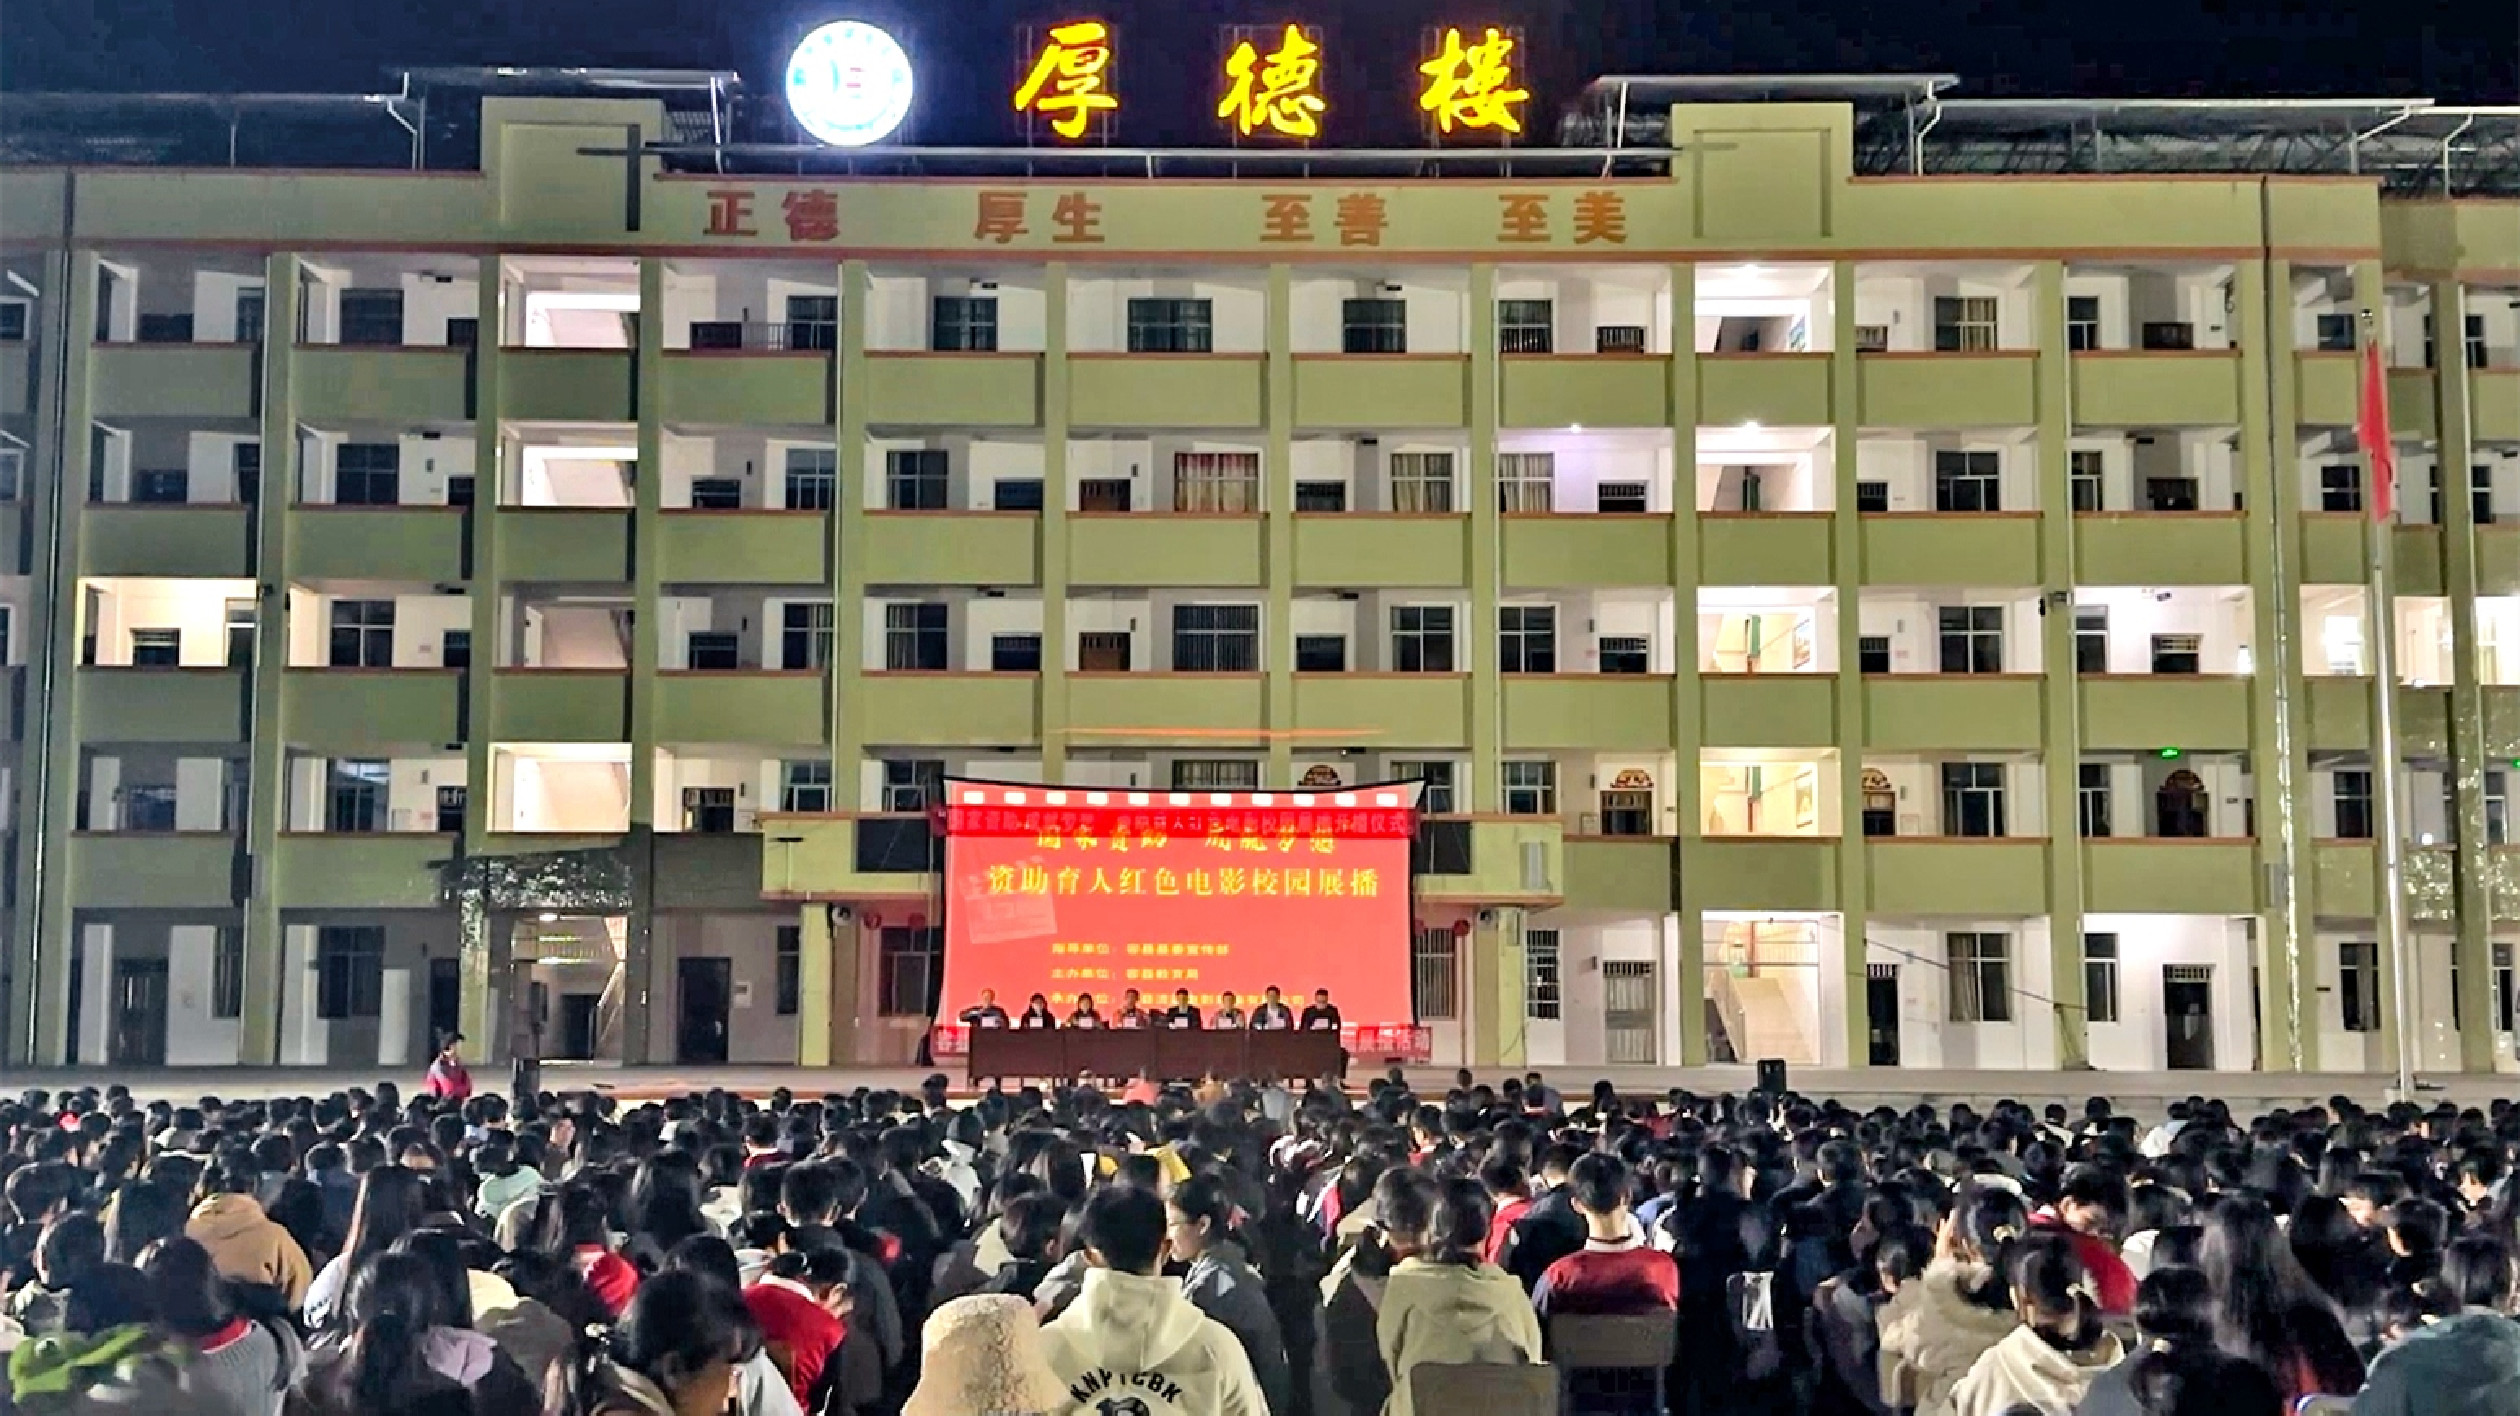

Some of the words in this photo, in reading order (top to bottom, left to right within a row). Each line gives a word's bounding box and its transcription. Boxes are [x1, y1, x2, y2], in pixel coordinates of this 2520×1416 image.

[1015, 21, 1529, 138] 厚德楼
[703, 191, 840, 241] 正德
[974, 192, 1105, 243] 厚生
[1260, 192, 1389, 246] 至善
[1496, 191, 1628, 243] 至美
[988, 865, 1378, 896] 资助育人红色电影校园展播
